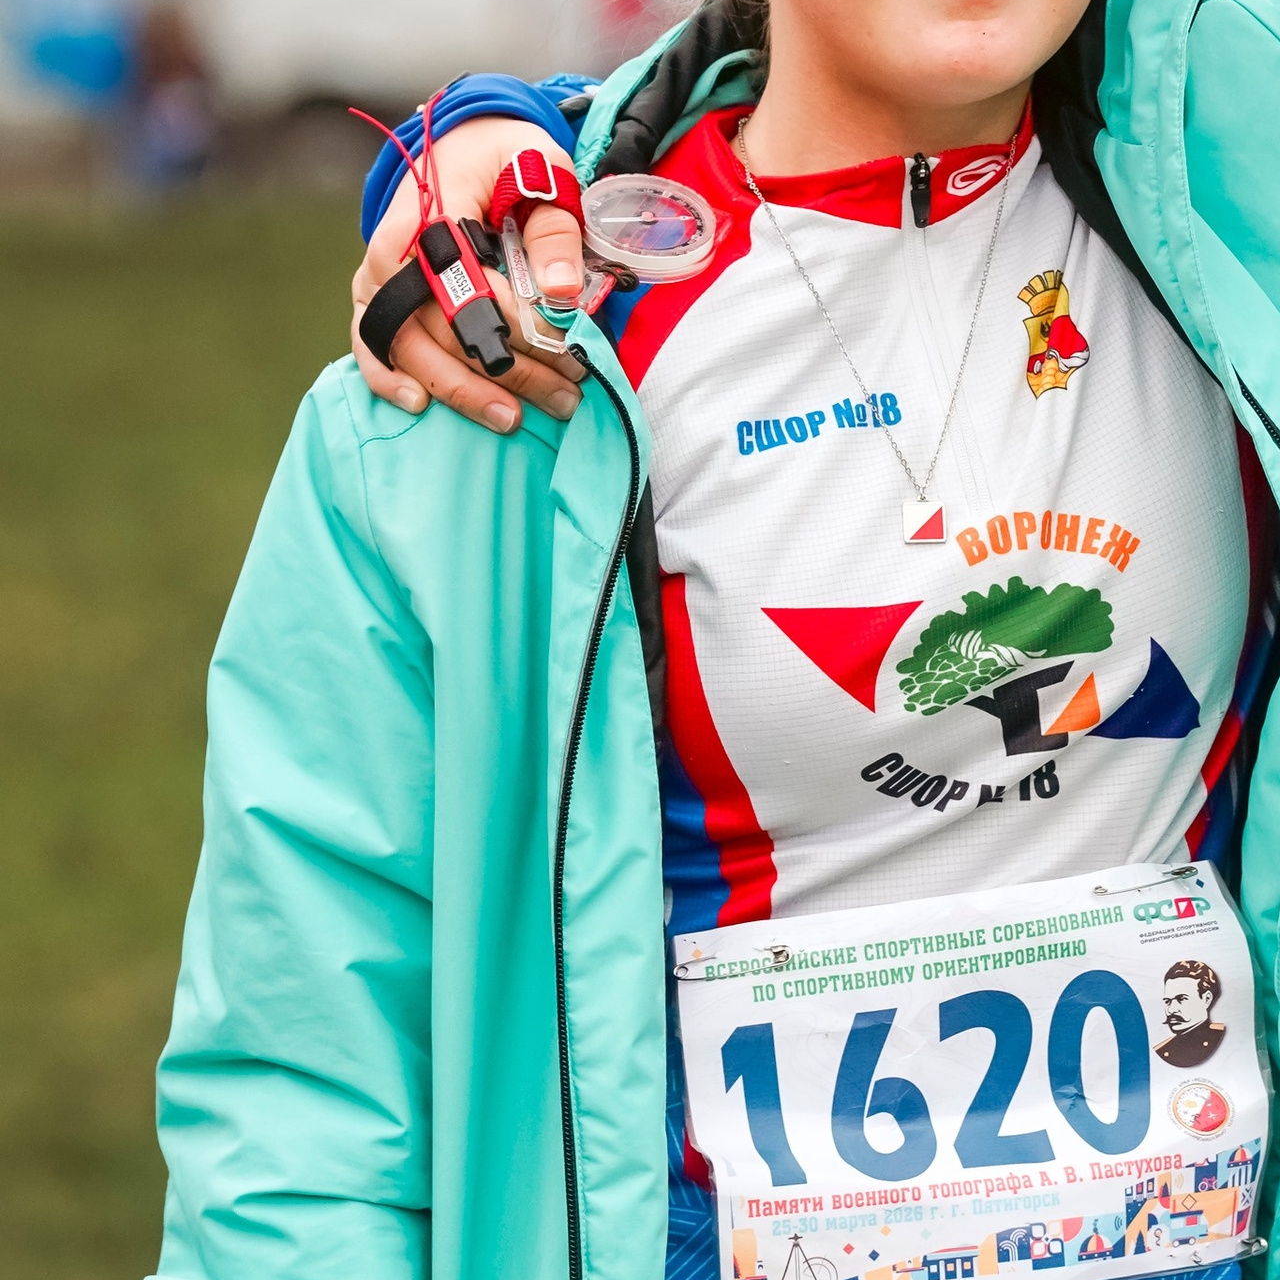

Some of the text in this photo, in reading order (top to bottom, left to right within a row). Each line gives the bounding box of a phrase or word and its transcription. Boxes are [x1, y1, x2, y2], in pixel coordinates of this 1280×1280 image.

[450, 264, 472, 295] 2153247
[735, 392, 902, 457] СШОР №18
[955, 509, 1142, 573] ВОРОНЕЖ
[860, 751, 970, 813] СШОР
[863, 929, 987, 962] СПОРТИВНЫЕ
[992, 905, 1124, 943] СОРЕВНОВАНИЯ
[1138, 920, 1218, 939] ФЕДЕРАЦИЯ СПОРТИВНОГО
[752, 938, 1088, 1003] ПО СПОРТИВНОМУ ОРИЕНТИРОВАНИЮ
[720, 969, 1152, 1188] 1620
[747, 1153, 1183, 1218] Памяти военного топографа А. В. Пастухова
[772, 1192, 1061, 1237] 25-30 марта 2026 г. г. Пятигорск
